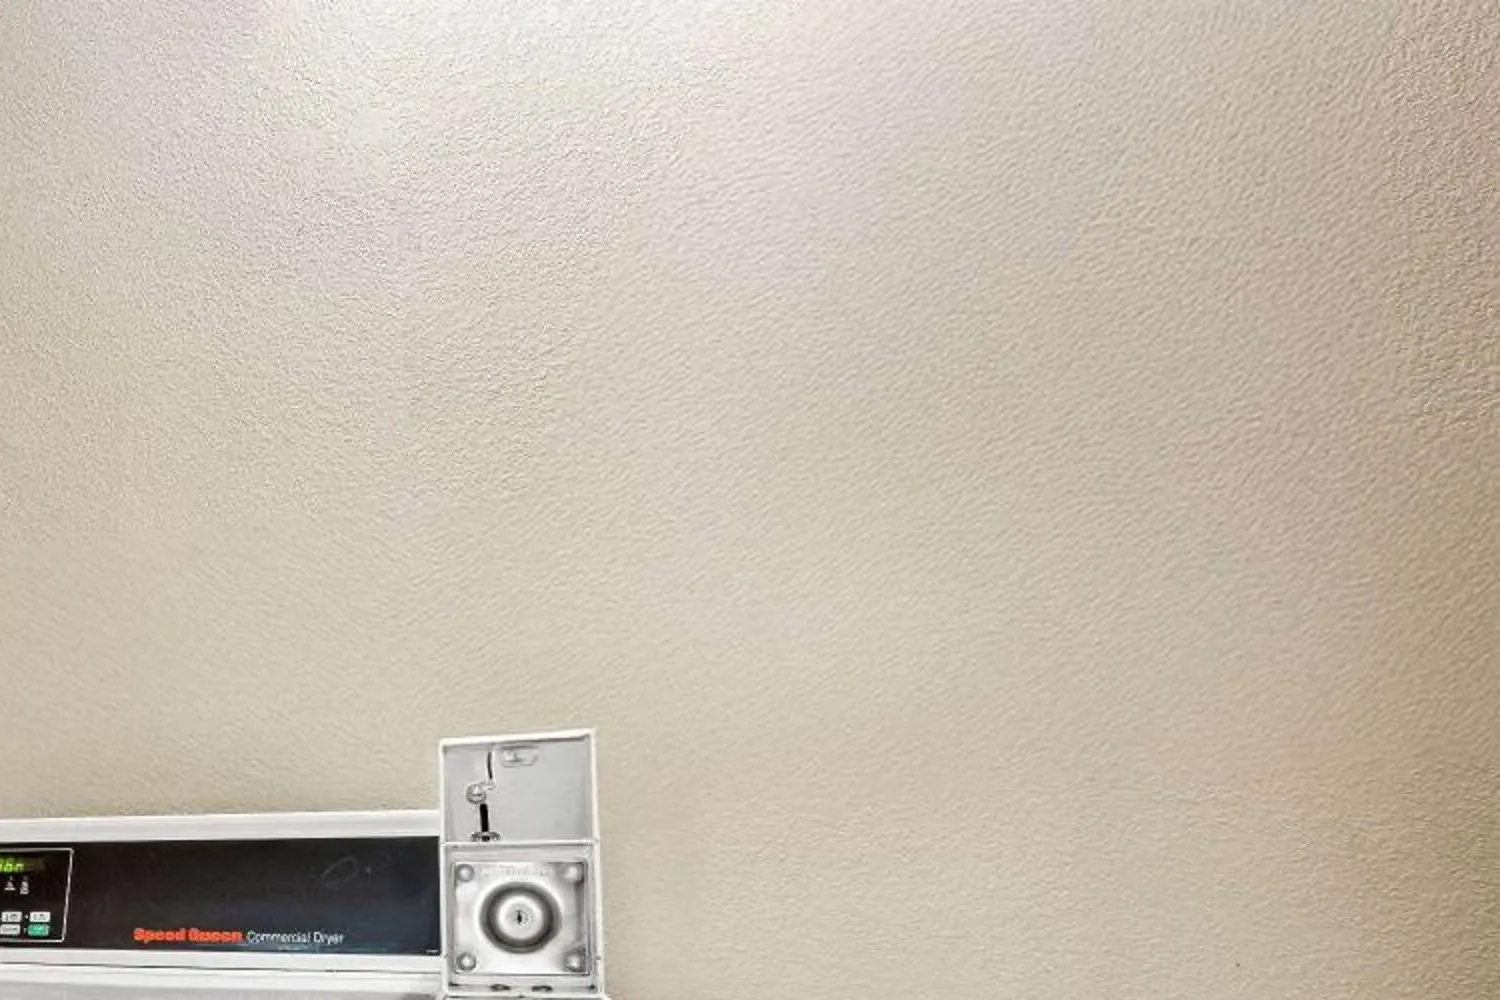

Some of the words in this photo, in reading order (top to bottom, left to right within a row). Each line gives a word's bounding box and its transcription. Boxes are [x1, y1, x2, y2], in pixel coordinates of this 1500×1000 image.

[133, 927, 186, 943] Speed
[188, 928, 243, 943] Queen
[247, 929, 311, 943] Commercial
[313, 931, 344, 945] Dryer
